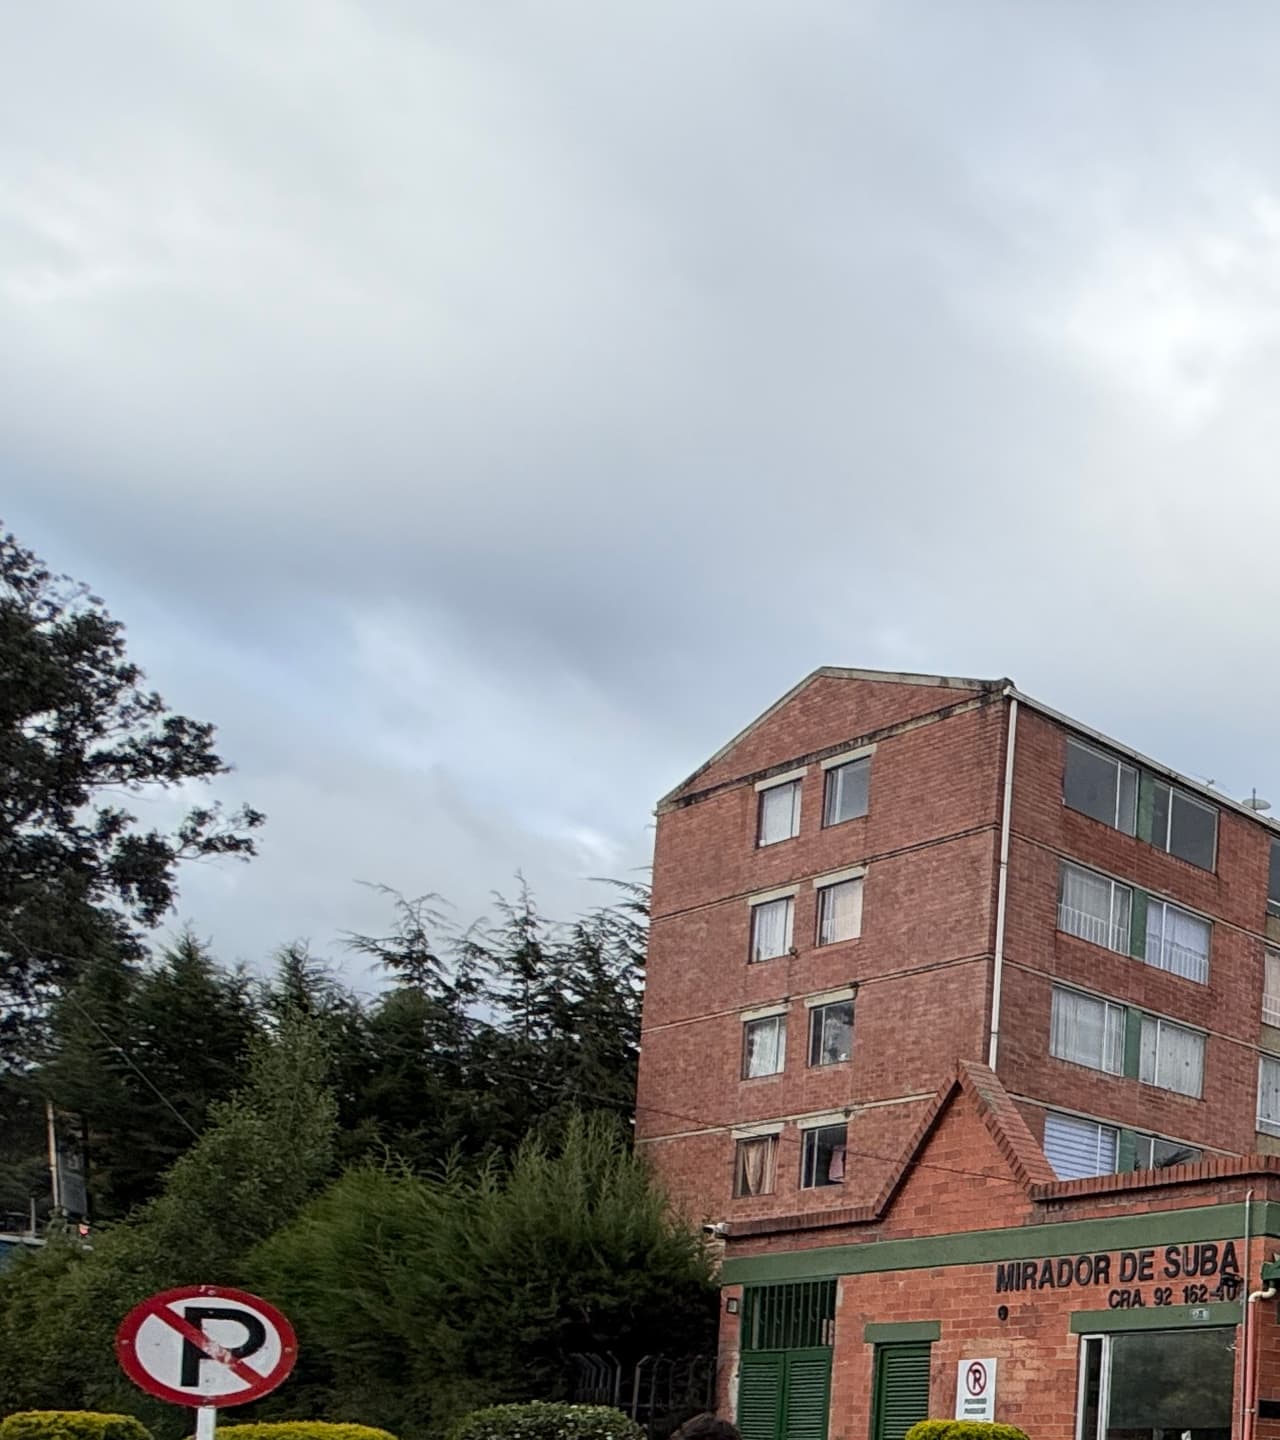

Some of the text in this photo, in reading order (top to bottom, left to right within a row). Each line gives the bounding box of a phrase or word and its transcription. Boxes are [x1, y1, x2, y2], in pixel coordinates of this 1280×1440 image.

[996, 1241, 1240, 1292] MIRADOR DE SUBA
[1108, 1288, 1145, 1308] CRA.
[1154, 1286, 1173, 1306] 92
